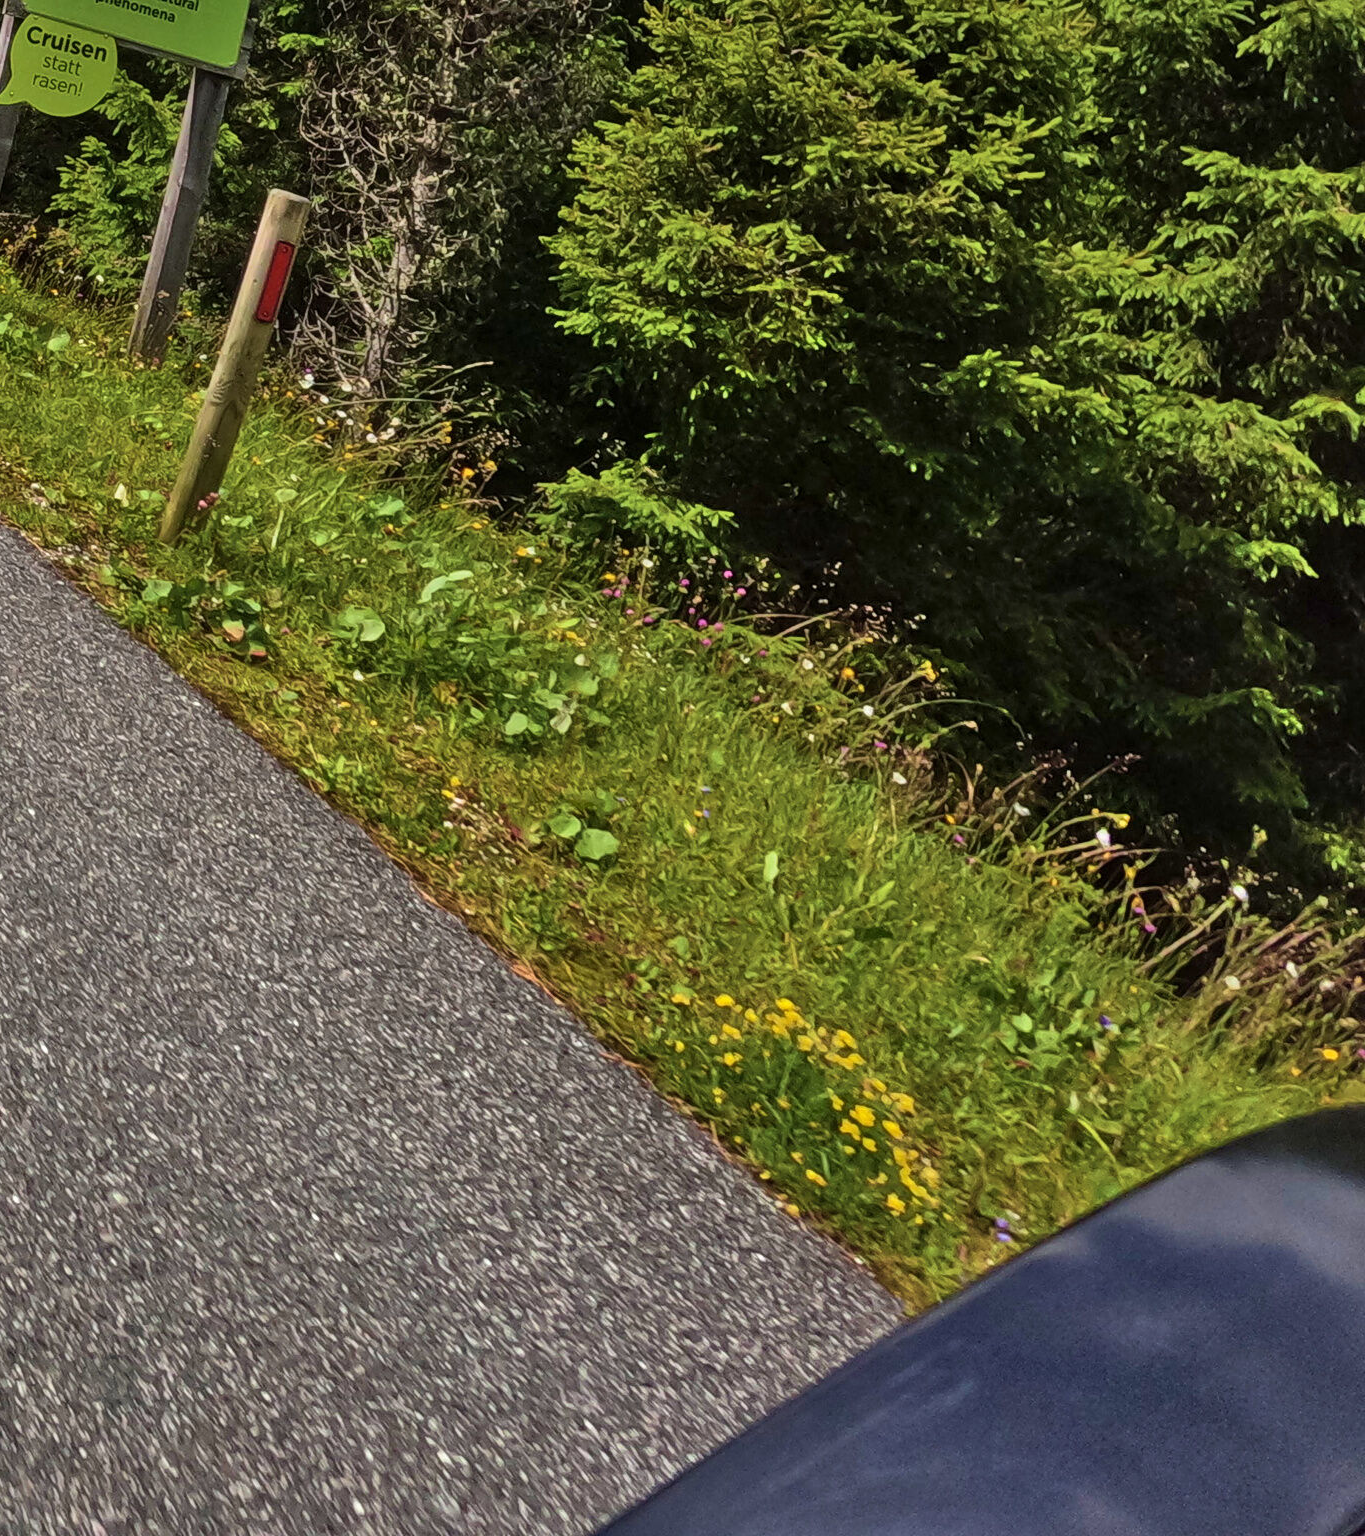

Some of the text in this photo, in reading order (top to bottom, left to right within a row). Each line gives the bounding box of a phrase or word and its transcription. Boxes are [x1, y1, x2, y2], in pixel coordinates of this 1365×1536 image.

[26, 26, 107, 62] Cruisen
[42, 55, 82, 76] statt
[32, 74, 83, 97] rasen!
